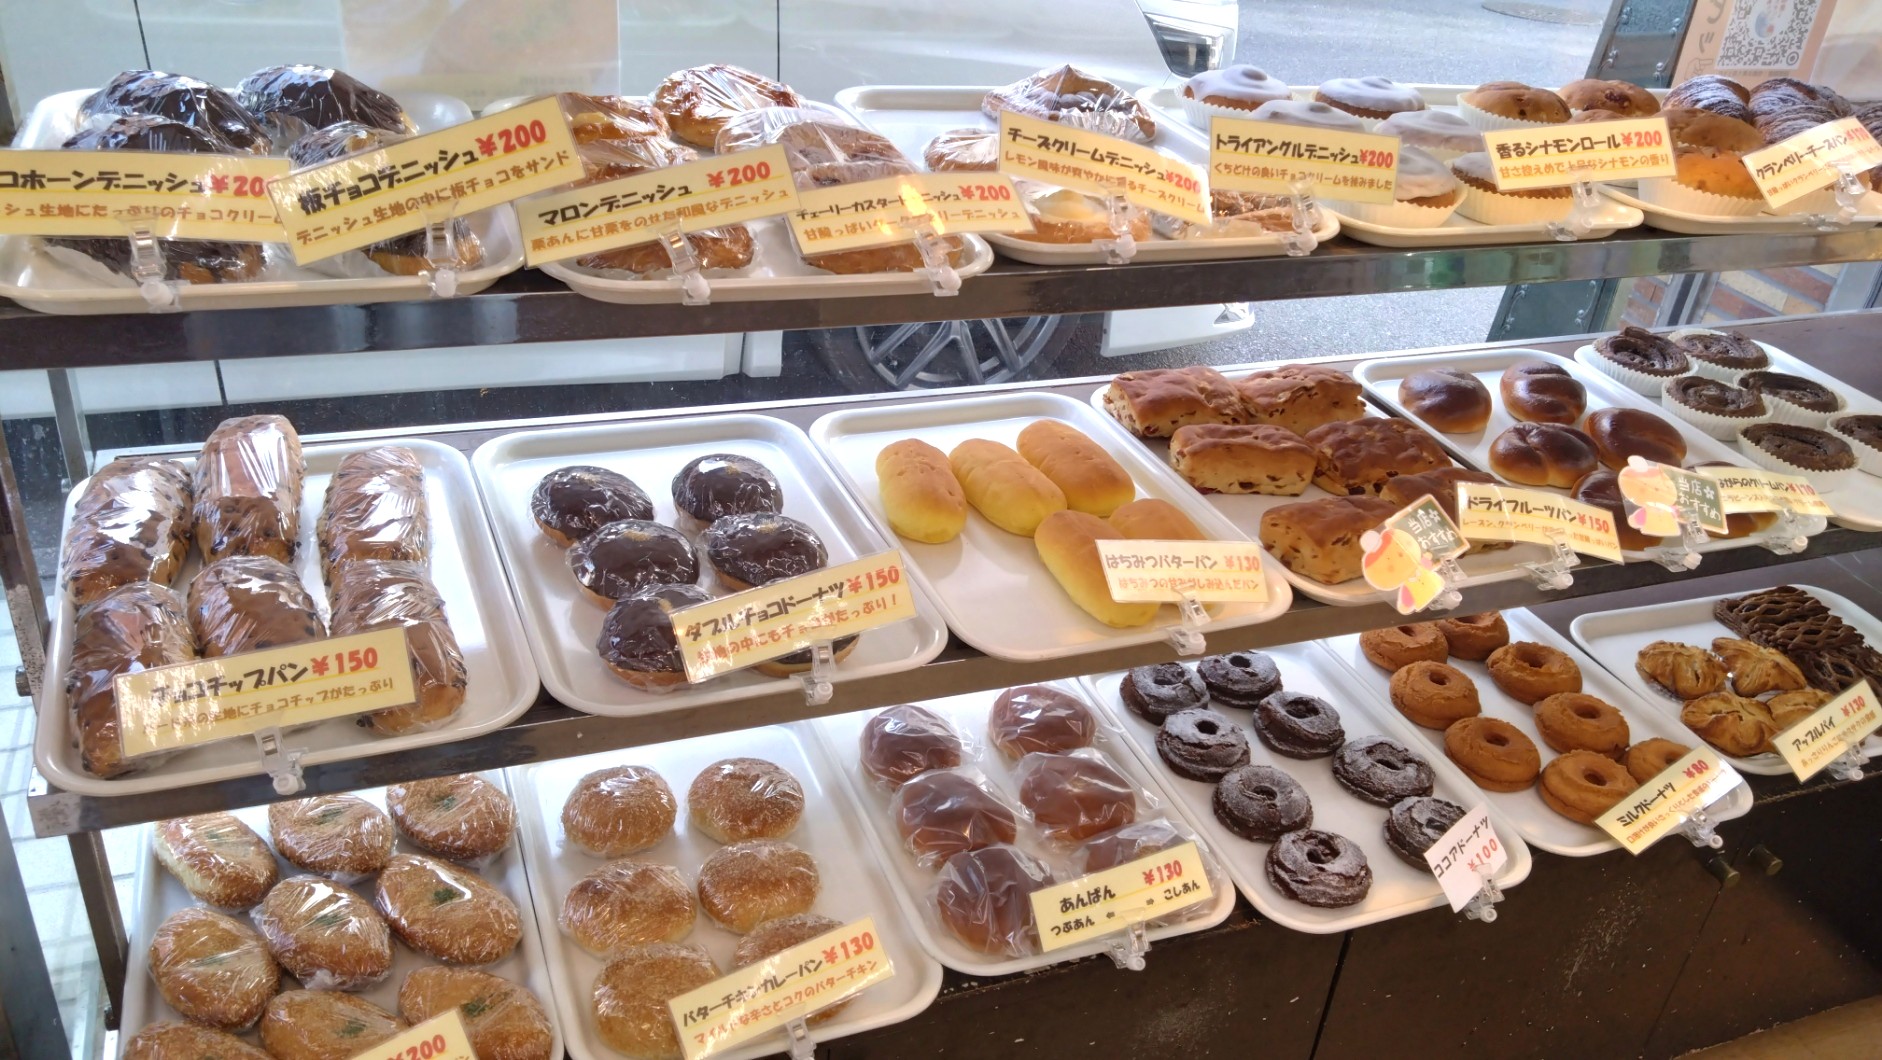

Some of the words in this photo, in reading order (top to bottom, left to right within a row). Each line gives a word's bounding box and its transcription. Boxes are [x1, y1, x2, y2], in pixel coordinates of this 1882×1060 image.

[1007, 126, 1166, 181] チーズクリームデニッシュ
[1215, 133, 1360, 164] トライアングルデニッシュ
[1359, 148, 1394, 169] ¥200
[1495, 134, 1621, 160] 香るシナモンロール
[1620, 130, 1663, 147] ¥200
[210, 174, 268, 197] ¥20
[297, 149, 479, 216] 板チョコデニッシュ
[475, 119, 547, 157] ¥200
[296, 150, 570, 246] デニッシュ生地の中に板チョコをサンド
[538, 183, 693, 226] マロンデニッシュ
[706, 161, 772, 189] ¥200
[795, 189, 962, 220] チェーリーカスターニッシュ
[960, 184, 1011, 201] ¥200
[1678, 476, 1702, 496] 当店
[1407, 509, 1432, 534] 当店
[1467, 495, 1578, 523] ドライフルーツパン
[1577, 511, 1610, 534] ¥150
[1678, 491, 1722, 521] おすすめ
[1417, 527, 1458, 550] おすすめ
[846, 565, 901, 594] ¥150
[1104, 554, 1218, 570] はちみつバターパン
[1223, 555, 1261, 571] ¥130
[310, 646, 379, 677] ¥150
[1792, 716, 1836, 752] アップルパイ
[1841, 695, 1866, 718] ¥130
[1616, 782, 1677, 828] ミルクドーナツ
[1682, 759, 1710, 780] ¥80
[1434, 816, 1489, 878] ココアドーナツ
[1467, 838, 1498, 872] ¥100
[1059, 884, 1117, 913] あんぱん
[1142, 859, 1183, 886] ¥130
[1050, 915, 1096, 936] つぶあん
[1163, 879, 1201, 900] こしあん
[822, 931, 875, 965] ¥130
